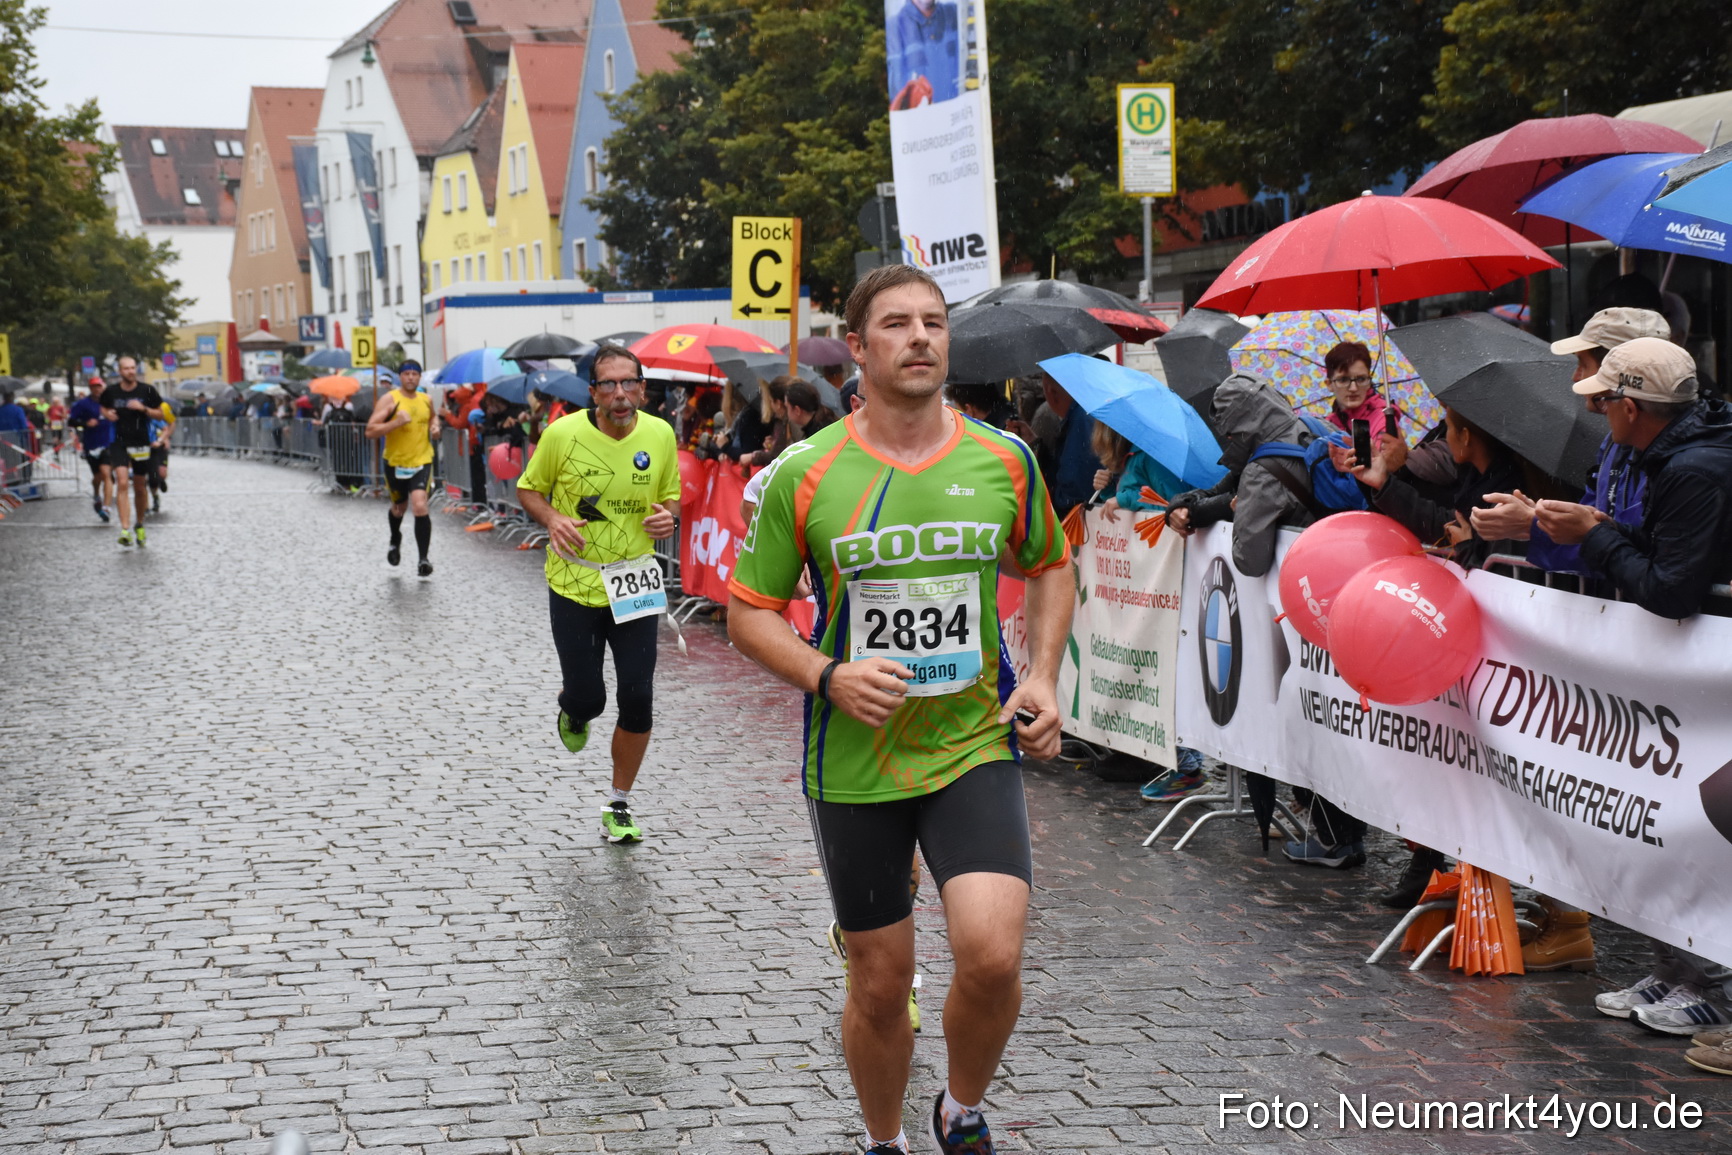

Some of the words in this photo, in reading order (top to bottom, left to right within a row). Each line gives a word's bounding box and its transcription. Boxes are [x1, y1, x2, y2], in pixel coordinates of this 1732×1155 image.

[1137, 102, 1155, 125] H
[741, 222, 792, 240] Block
[1666, 221, 1727, 242] MAINTAL
[749, 248, 782, 298] C
[358, 339, 370, 358] D
[830, 521, 1002, 574] BOCK
[610, 567, 661, 598] 2843
[908, 578, 969, 597] BOCK
[633, 599, 655, 610] Claus
[864, 603, 970, 651] 2834
[1410, 608, 1443, 639] energie
[1300, 687, 1364, 740] WENIGER
[1368, 705, 1484, 776] VERBRAUCH.
[1521, 760, 1665, 848] FAHRFREUDE.
